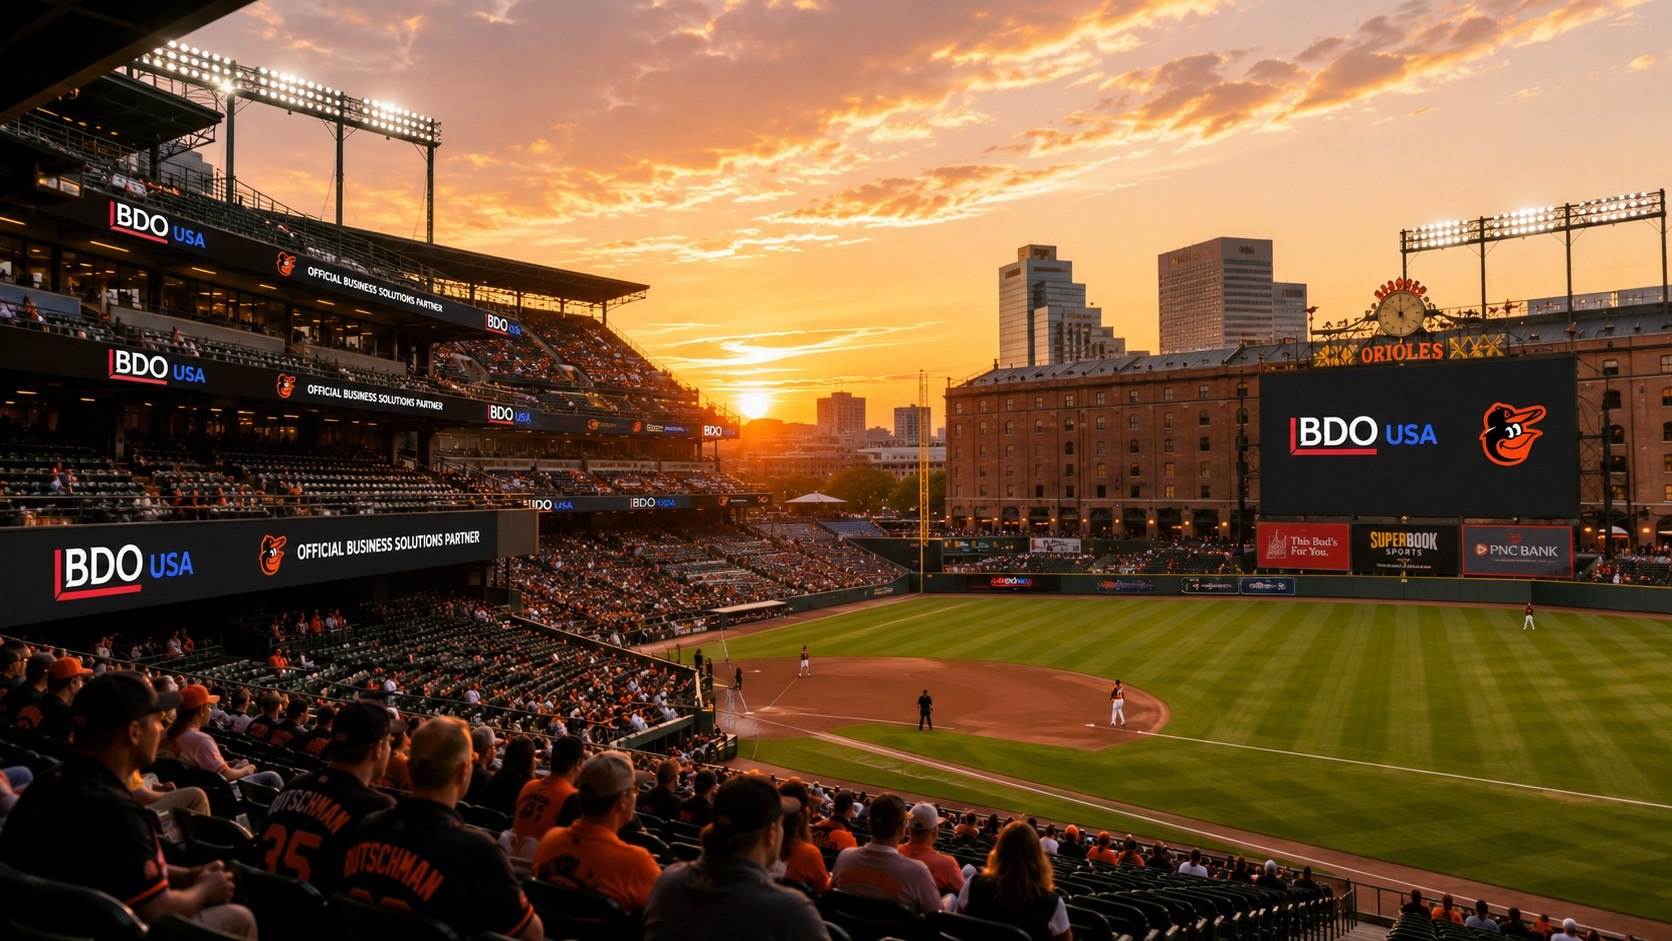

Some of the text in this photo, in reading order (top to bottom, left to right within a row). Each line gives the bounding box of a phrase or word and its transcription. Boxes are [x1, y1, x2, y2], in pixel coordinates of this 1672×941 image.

[117, 202, 206, 249] BDO USA
[307, 266, 342, 285] OFFICIAL
[487, 313, 508, 332] BDO
[1361, 342, 1444, 364] ORIOLES
[115, 349, 206, 384] BDO USA
[307, 384, 342, 398] OFFICIAL
[343, 389, 378, 402] BUSINESS
[490, 405, 514, 421] BDO
[704, 425, 722, 436] BDO
[1299, 415, 1438, 446] BDO USA
[633, 497, 656, 508] BDO
[296, 530, 481, 561] OFFICIAL BUSINESS SOLUTIONS PARTNER
[1370, 531, 1438, 551] SUPERBOOK
[1291, 546, 1307, 556] For
[1385, 548, 1423, 557] SPORTS
[1490, 545, 1558, 557] PNC BANK
[65, 543, 195, 588] BDO USA
[261, 822, 324, 883] 35
